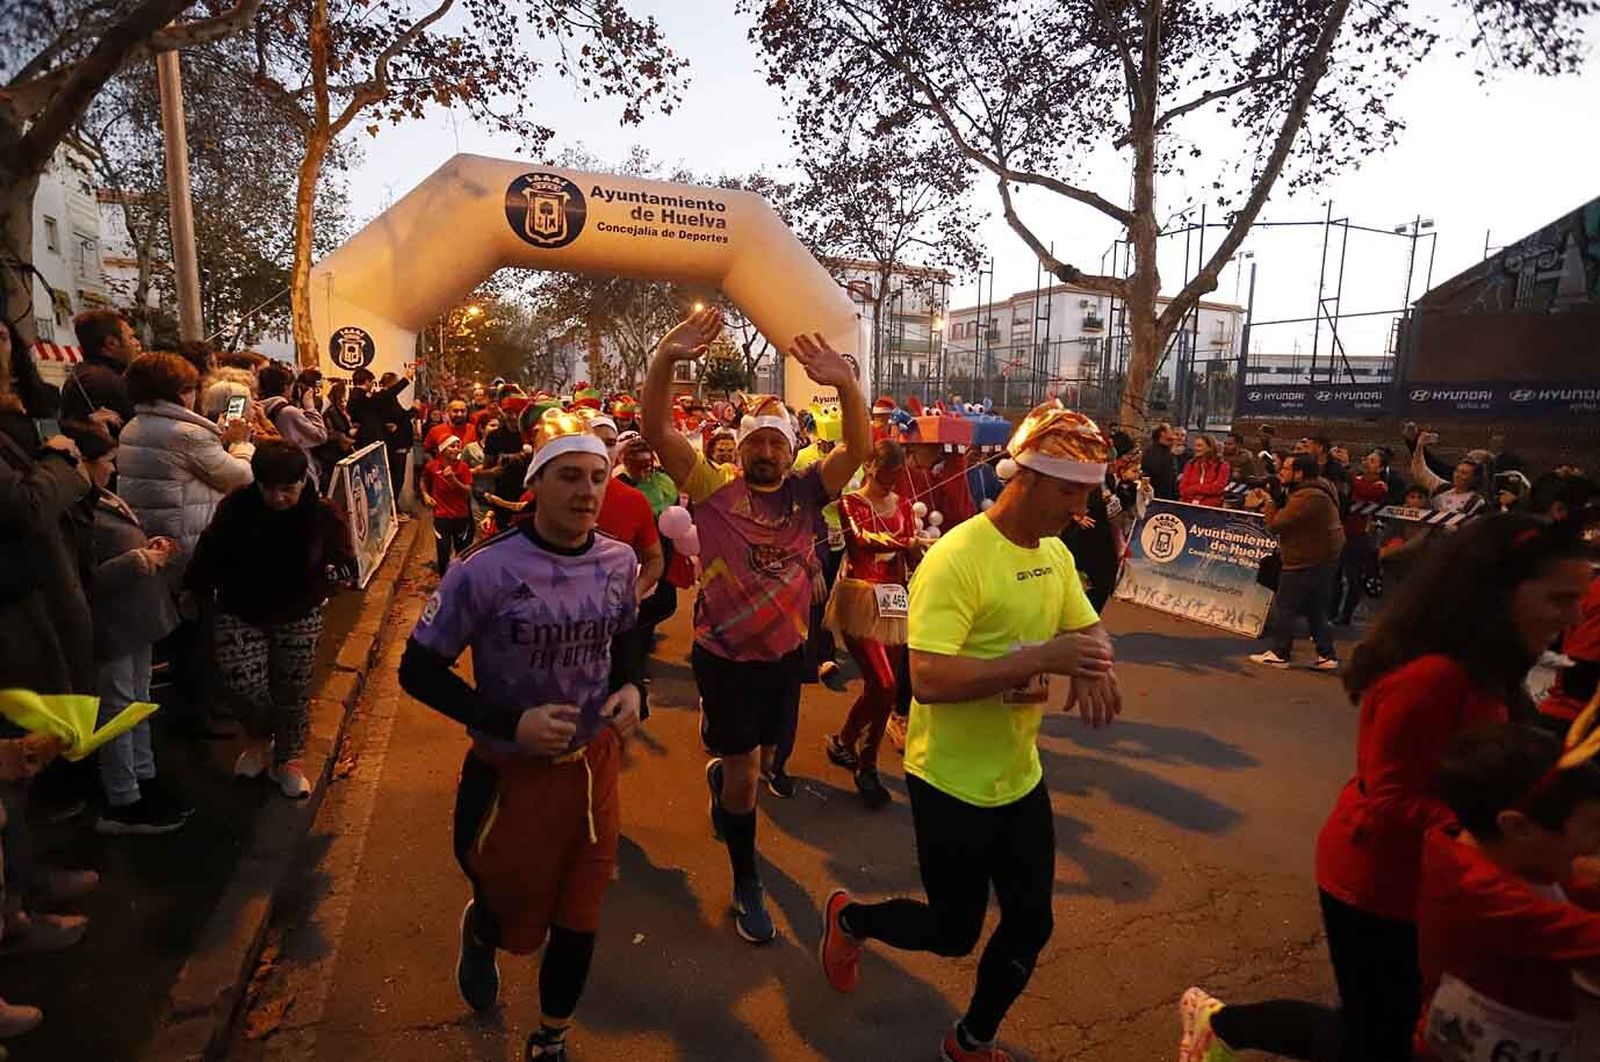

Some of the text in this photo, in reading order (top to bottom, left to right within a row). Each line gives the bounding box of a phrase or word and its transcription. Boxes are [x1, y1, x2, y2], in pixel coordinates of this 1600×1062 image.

[590, 186, 726, 212] Ayuntamiento
[631, 206, 727, 230] de Huelva
[661, 229, 676, 239] de
[679, 230, 729, 244] Deportes
[1263, 391, 1305, 401] HYUNDAI
[1334, 391, 1383, 401] HYUNDAI
[1432, 390, 1493, 400] HYUNDAI
[1188, 523, 1278, 549] Ayuntamiento
[1210, 540, 1273, 560] de Huelv
